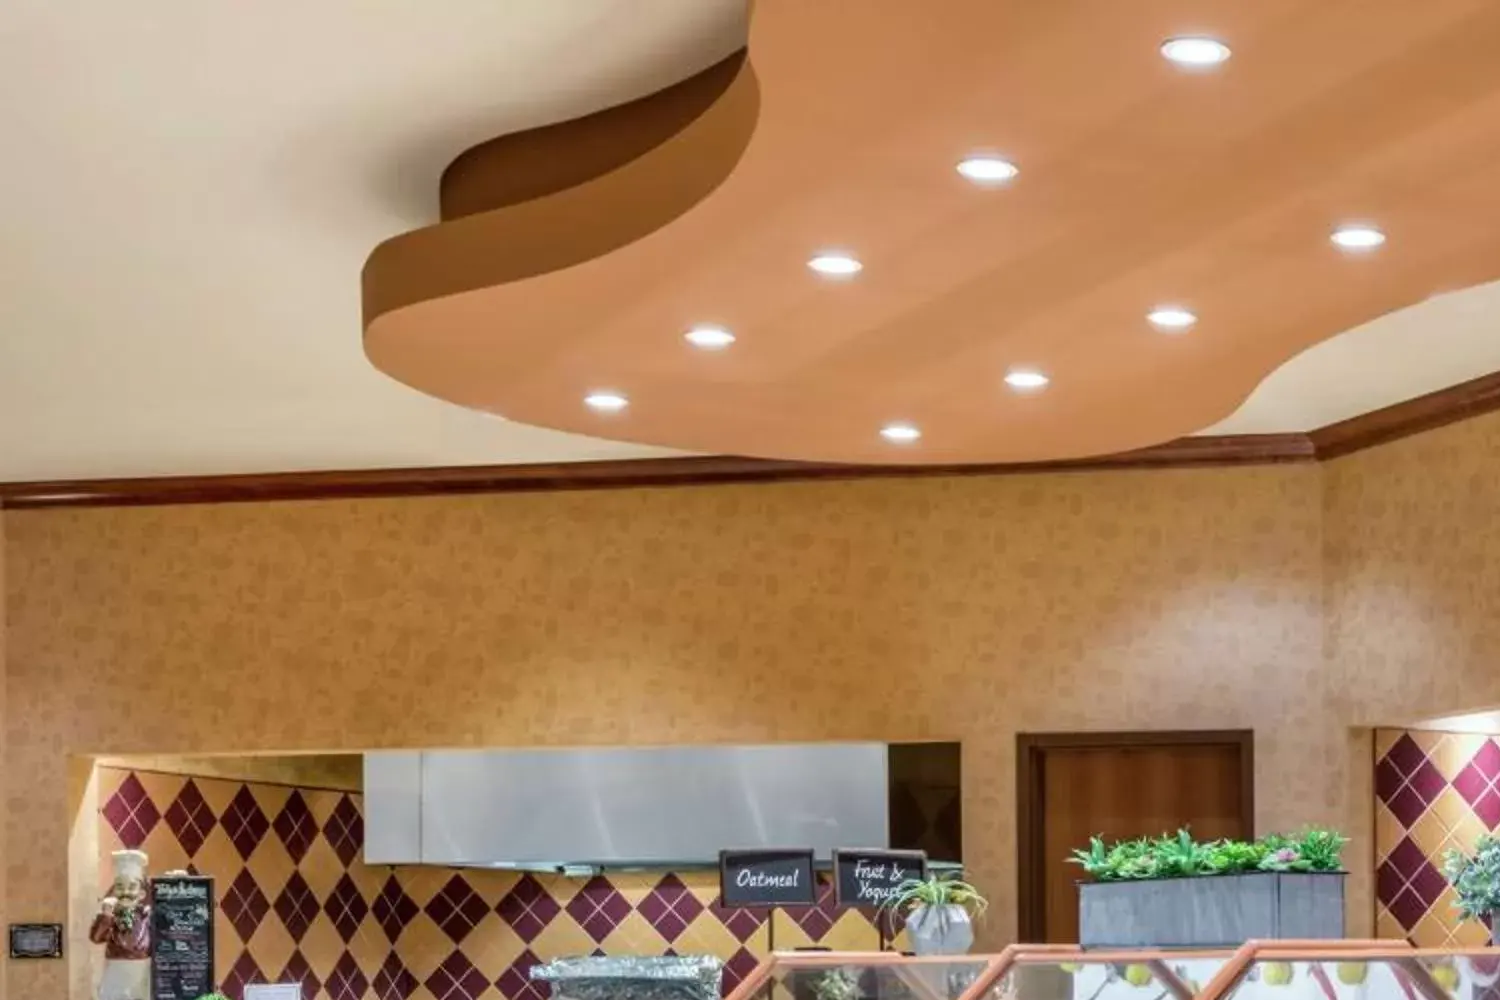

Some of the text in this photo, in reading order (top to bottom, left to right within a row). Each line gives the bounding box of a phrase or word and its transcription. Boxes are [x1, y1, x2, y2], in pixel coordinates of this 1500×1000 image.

[736, 868, 799, 888] Oatmeal
[855, 859, 905, 881] Fruit &
